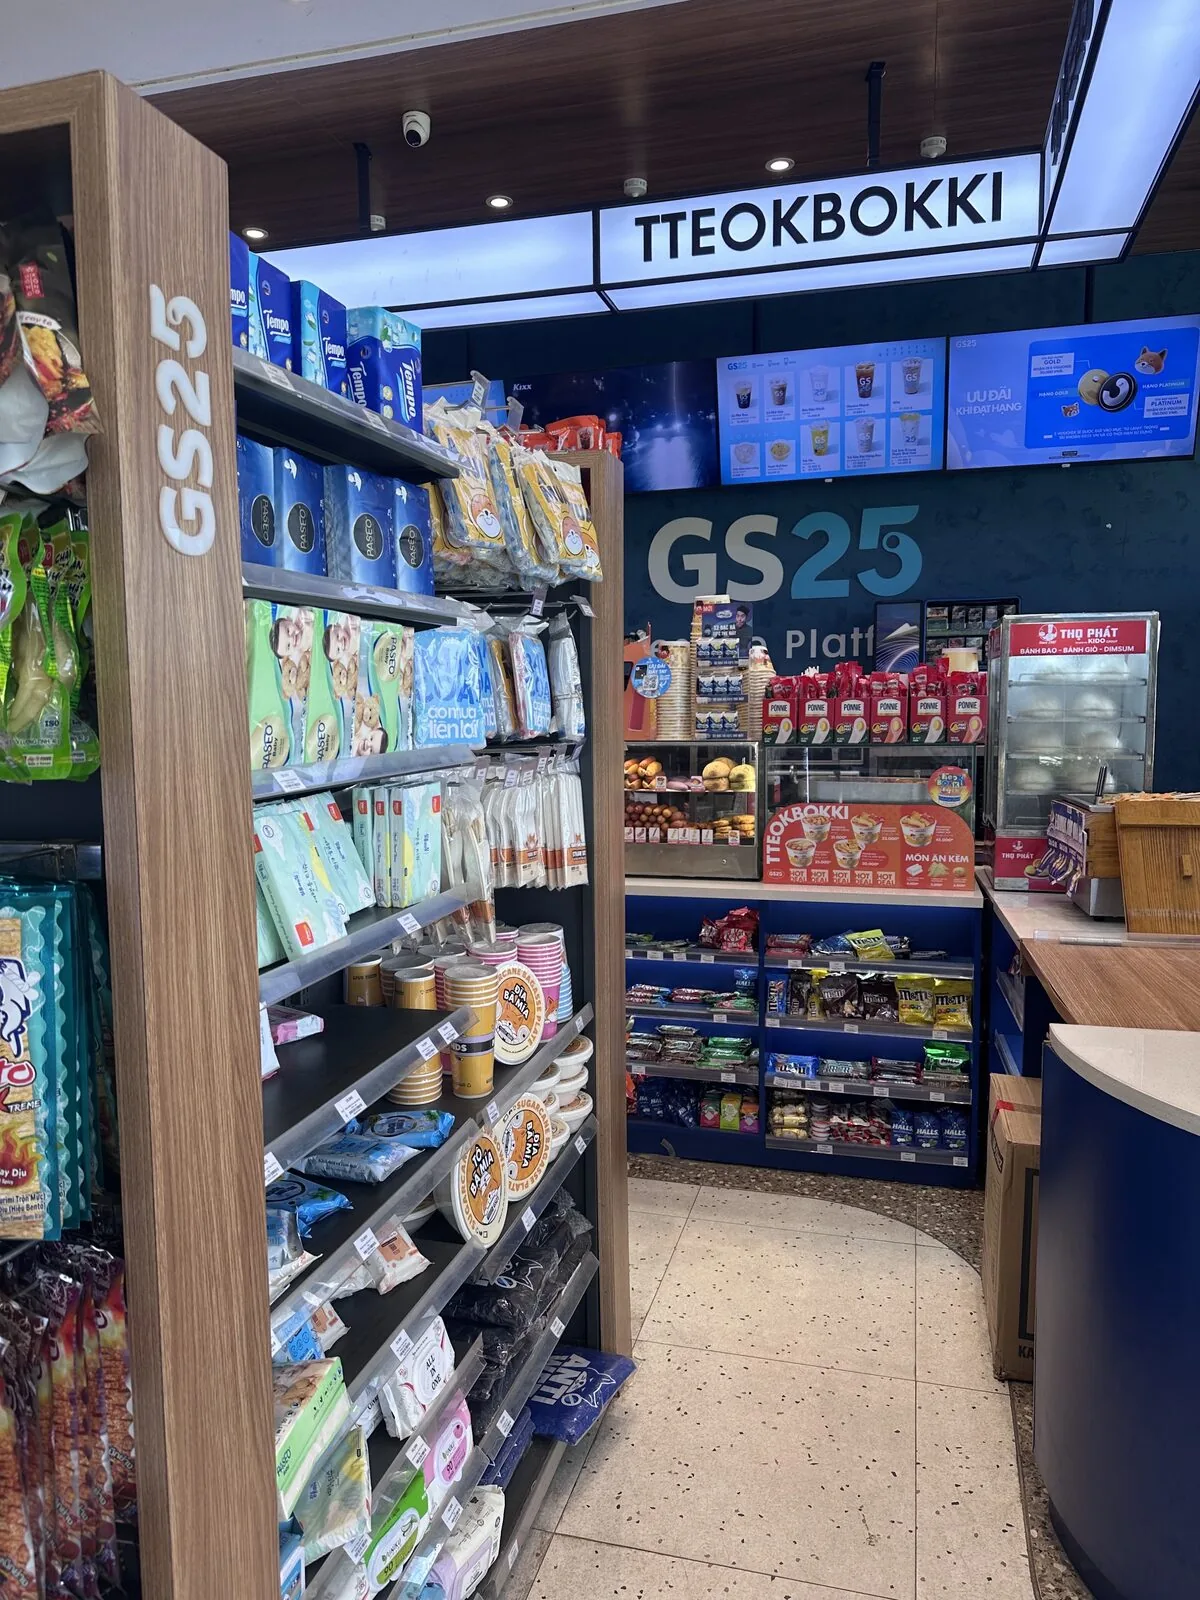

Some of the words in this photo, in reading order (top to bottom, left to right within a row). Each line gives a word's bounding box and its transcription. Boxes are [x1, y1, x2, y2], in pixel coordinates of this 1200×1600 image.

[635, 171, 1003, 263] TTEOKBOKKI
[263, 310, 290, 332] Tempo
[322, 336, 345, 357] Tempo
[401, 359, 416, 418] Tempo
[150, 283, 216, 556] GS25
[261, 498, 270, 541] PASEO
[366, 518, 374, 557] PASEO
[648, 505, 923, 604] GS25
[1060, 629, 1083, 641] THỌ
[1087, 625, 1119, 638] PHÁT
[388, 637, 398, 675] PASEO
[1020, 646, 1040, 655] BÁNH
[1085, 645, 1098, 653] GIÒ
[766, 804, 849, 865] TTEOKBOKKI
[905, 853, 929, 862] MÓN
[892, 1123, 913, 1131] HALLS
[916, 1128, 939, 1136] HALLS
[944, 1128, 967, 1136] HALLS
[12, 1168, 27, 1178] Dịu
[426, 1354, 436, 1371] ALL
[430, 1365, 437, 1377] IN
[431, 1373, 442, 1391] ONE
[383, 1562, 395, 1576] 90
